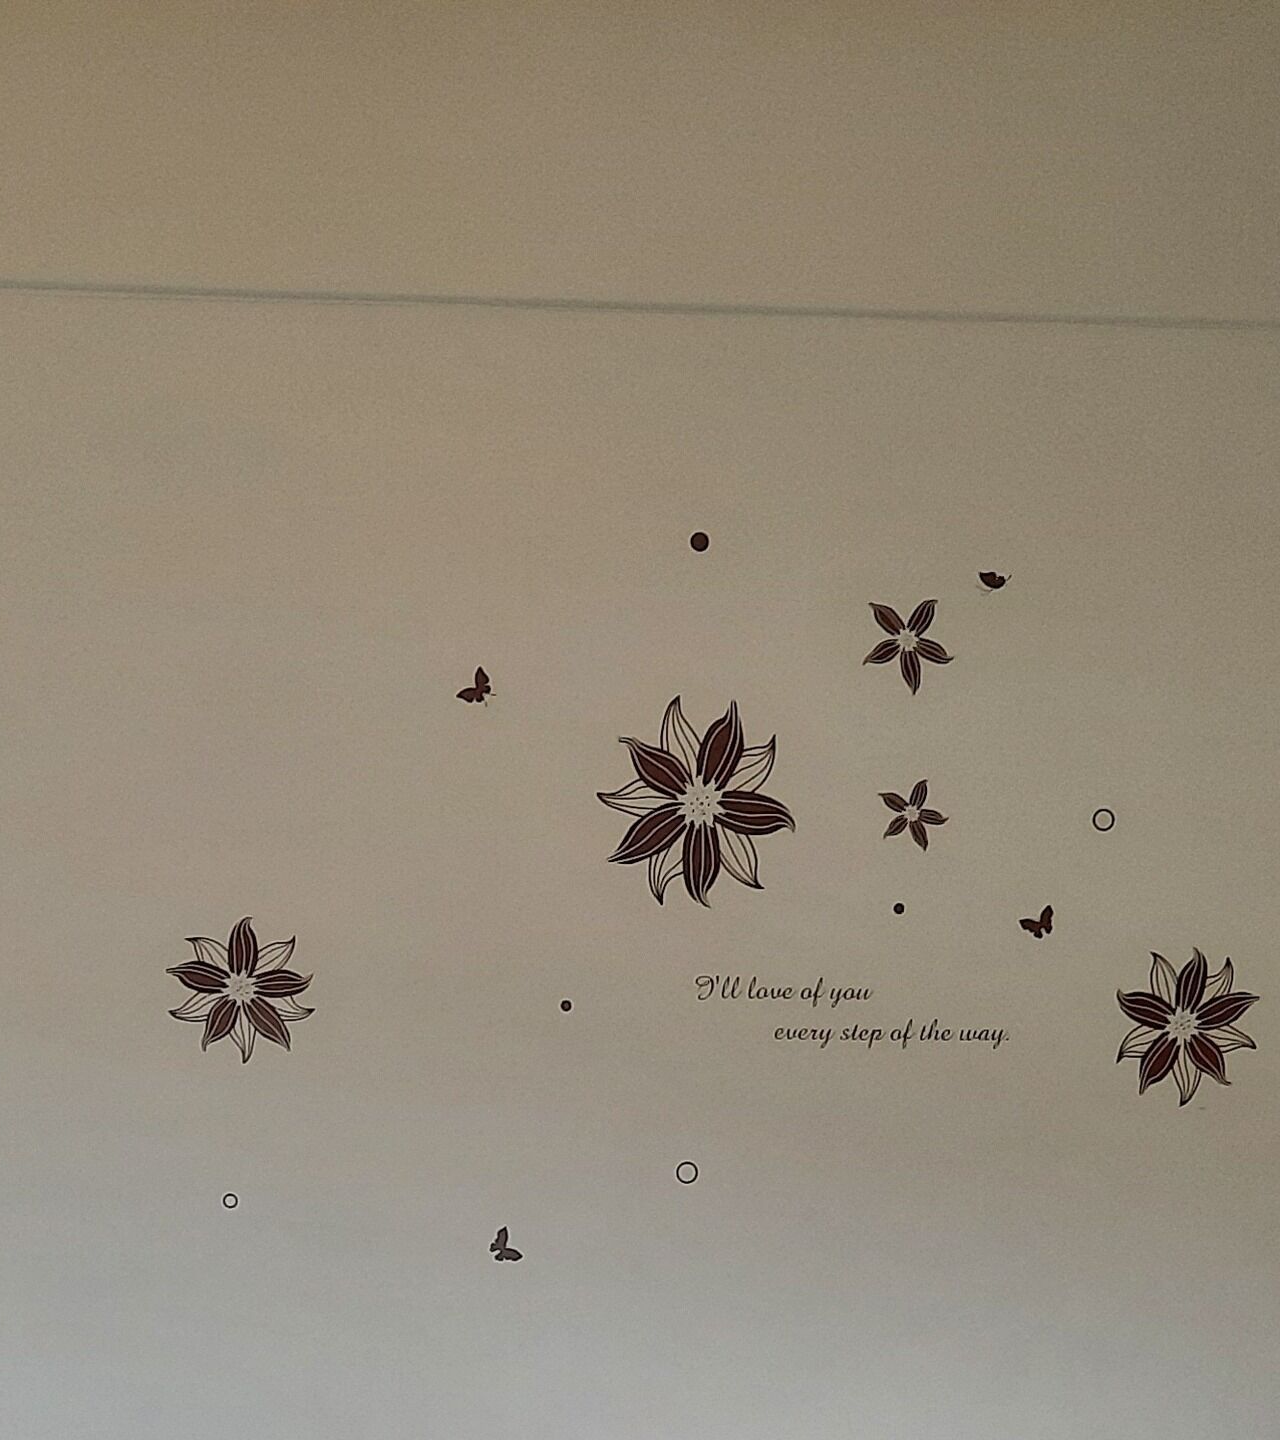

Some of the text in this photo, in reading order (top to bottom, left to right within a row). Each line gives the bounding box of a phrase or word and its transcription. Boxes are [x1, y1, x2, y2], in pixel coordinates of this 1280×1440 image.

[695, 974, 872, 1008] I'll love of you
[773, 1019, 1010, 1049] every step of the way.
